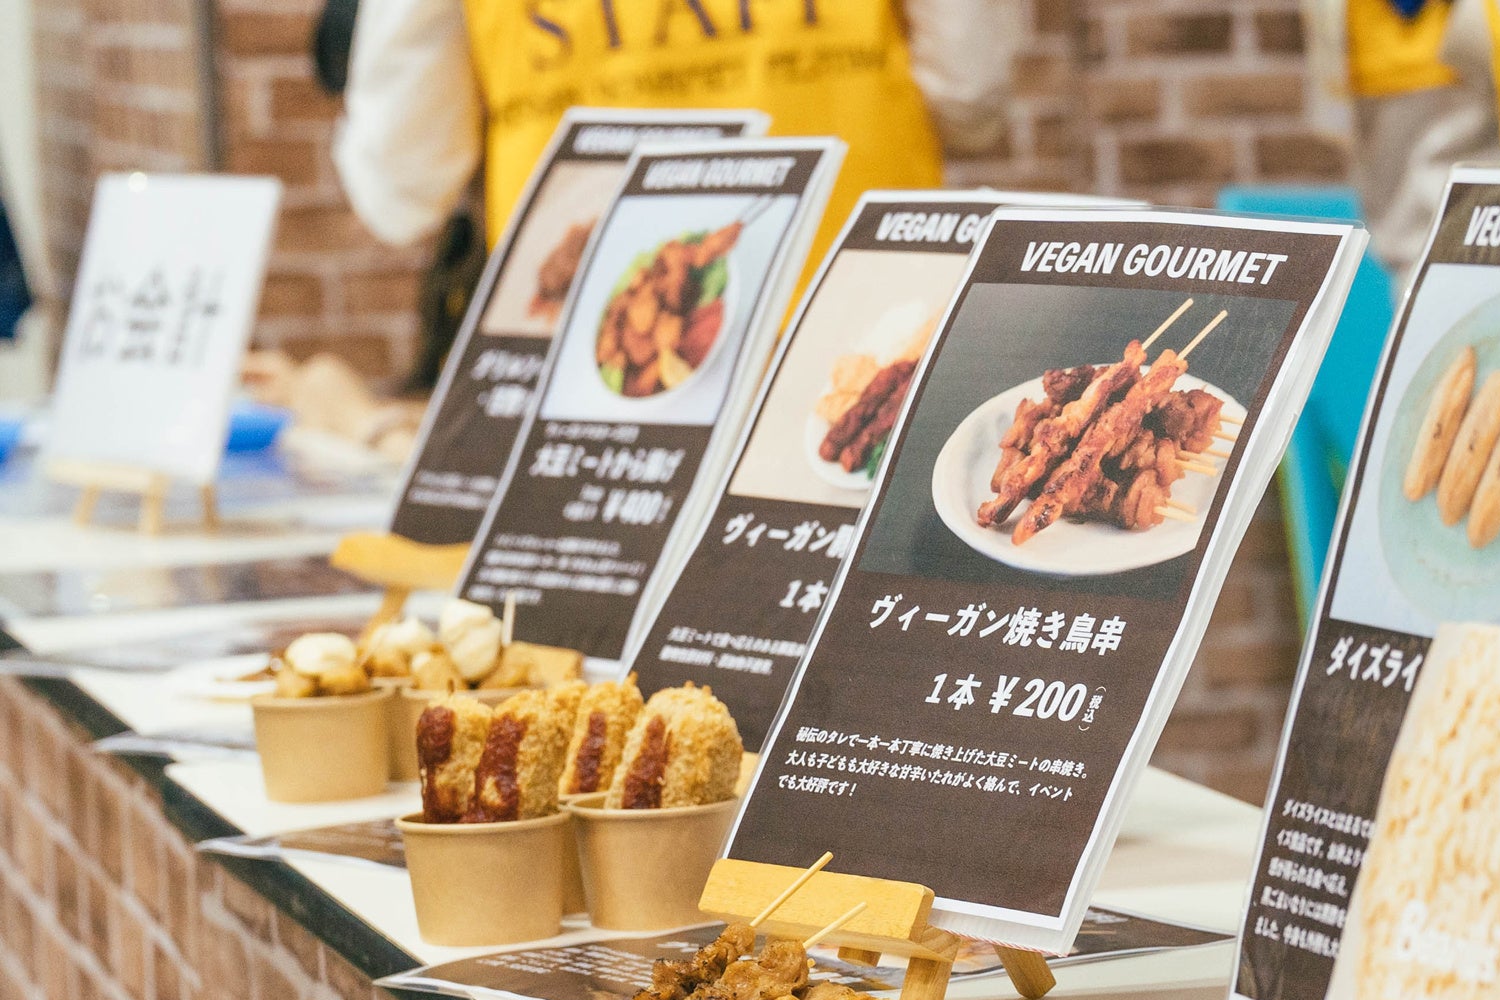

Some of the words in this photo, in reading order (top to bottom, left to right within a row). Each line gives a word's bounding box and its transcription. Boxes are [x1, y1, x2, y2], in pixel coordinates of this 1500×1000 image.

[874, 211, 960, 243] VEGAN
[1019, 241, 1119, 276] VEGAN
[1122, 243, 1288, 286] GOURMET
[869, 594, 1127, 656] ヴィーガン焼き鳥串
[924, 673, 982, 711] 1本
[988, 675, 1088, 722] ¥200
